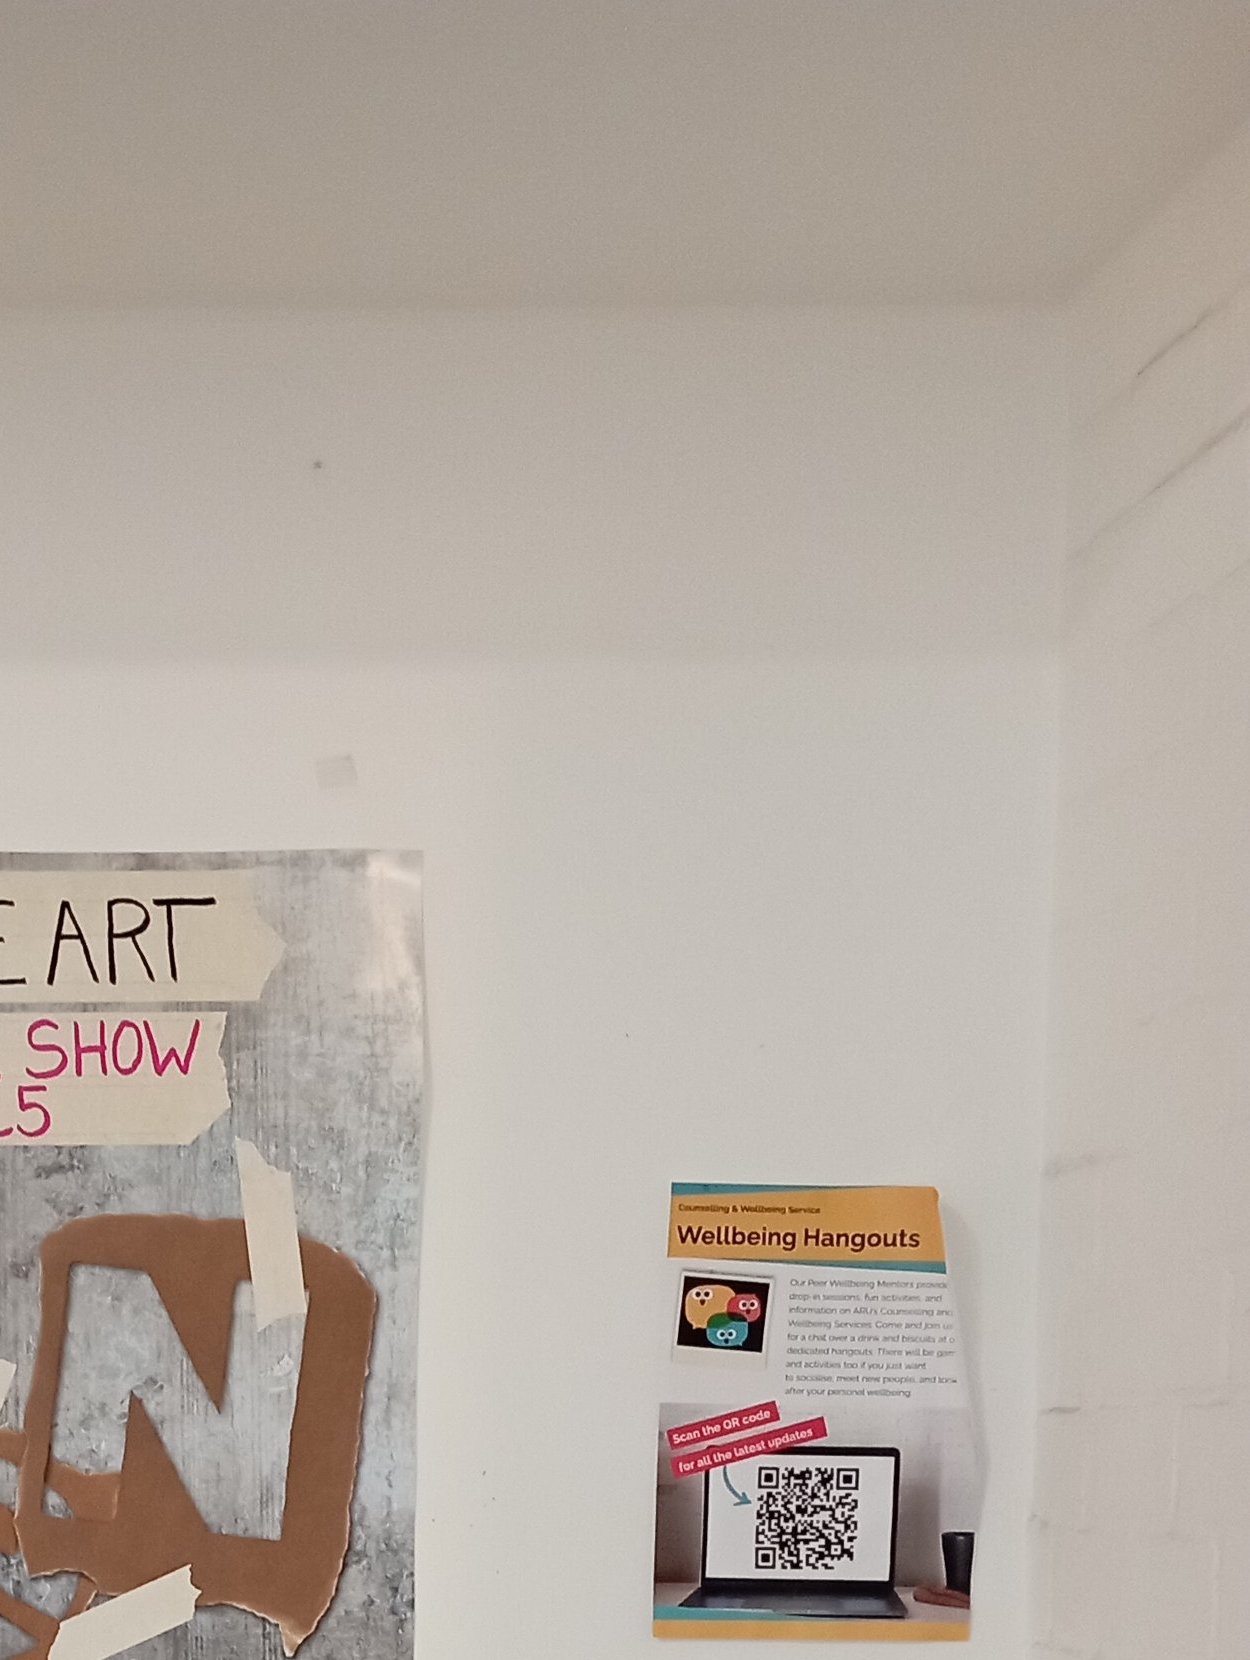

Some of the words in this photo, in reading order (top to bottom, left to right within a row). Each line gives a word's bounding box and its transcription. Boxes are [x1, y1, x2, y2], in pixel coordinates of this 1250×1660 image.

[47, 897, 216, 985] ART
[26, 1018, 203, 1082] SHOW
[677, 1225, 797, 1252] Wellbeing
[803, 1228, 920, 1253] Hangouts
[672, 1429, 701, 1444] Scan
[702, 1423, 721, 1436] the
[723, 1417, 740, 1430] QR
[742, 1410, 770, 1424] code
[679, 1462, 694, 1472] for
[697, 1456, 710, 1467] all
[713, 1449, 732, 1462] the
[734, 1440, 766, 1457] latest
[767, 1428, 813, 1448] updates
